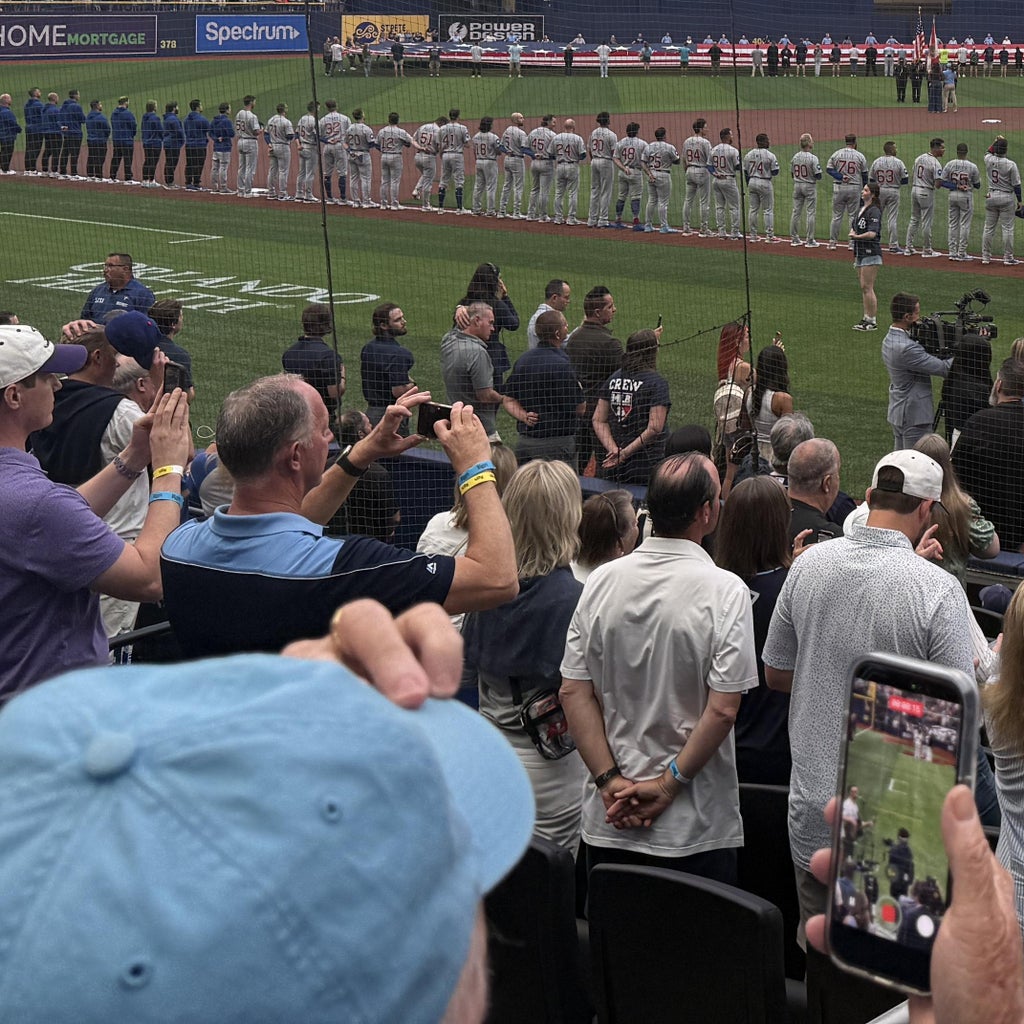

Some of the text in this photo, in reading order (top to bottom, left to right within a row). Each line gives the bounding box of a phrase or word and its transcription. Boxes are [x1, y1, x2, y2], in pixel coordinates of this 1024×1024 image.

[67, 33, 145, 45] MORTGAGE
[205, 21, 294, 45] Spectrum
[470, 32, 534, 42] DESIN
[160, 40, 177, 49] 378
[325, 122, 339, 135] 32
[381, 138, 395, 150] 12
[443, 134, 454, 146] 41
[592, 139, 604, 151] 30
[621, 147, 636, 160] 48
[749, 161, 763, 175] 74
[839, 161, 856, 174] 76
[609, 378, 643, 392] CREW
